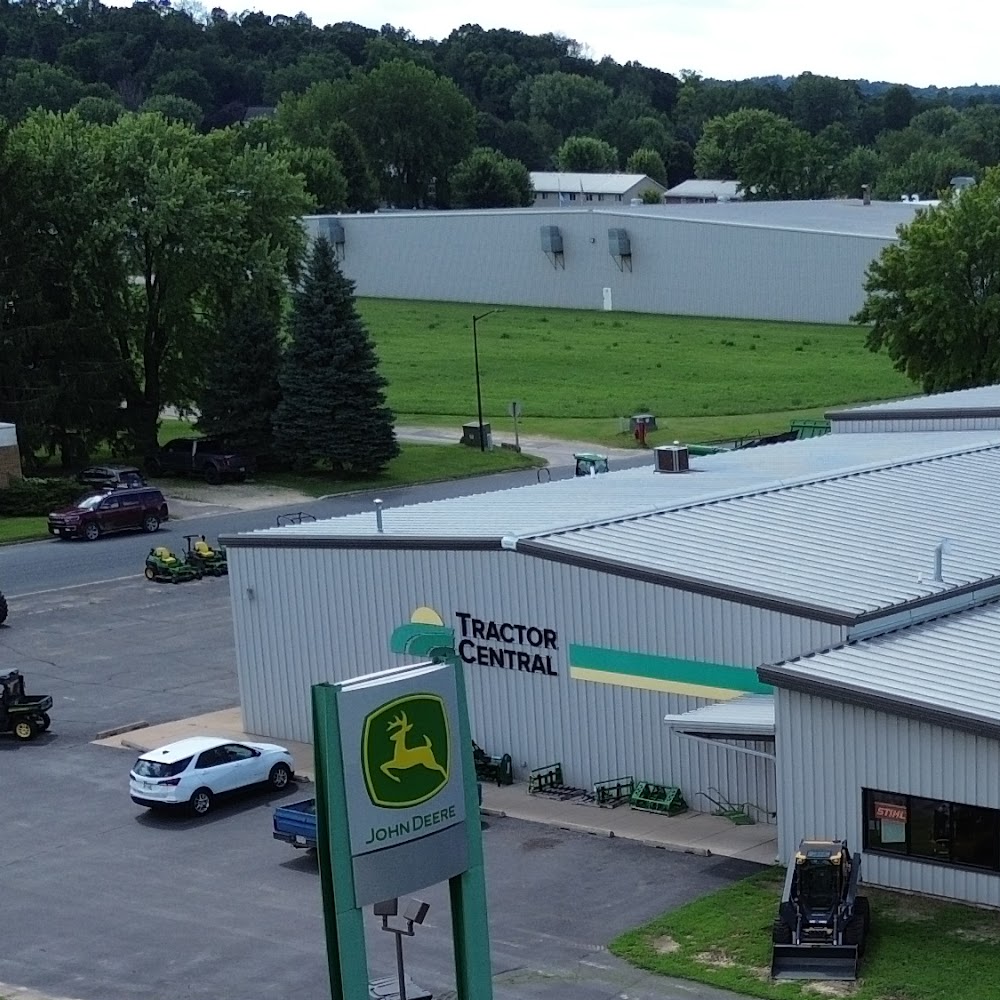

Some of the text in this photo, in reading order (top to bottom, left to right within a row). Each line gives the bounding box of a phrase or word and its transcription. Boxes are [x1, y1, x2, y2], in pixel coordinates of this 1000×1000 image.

[455, 611, 558, 650] TRACTOR
[458, 638, 558, 677] CENTRAL
[365, 805, 456, 845] JOHN DEERE
[876, 807, 907, 820] STIHL
